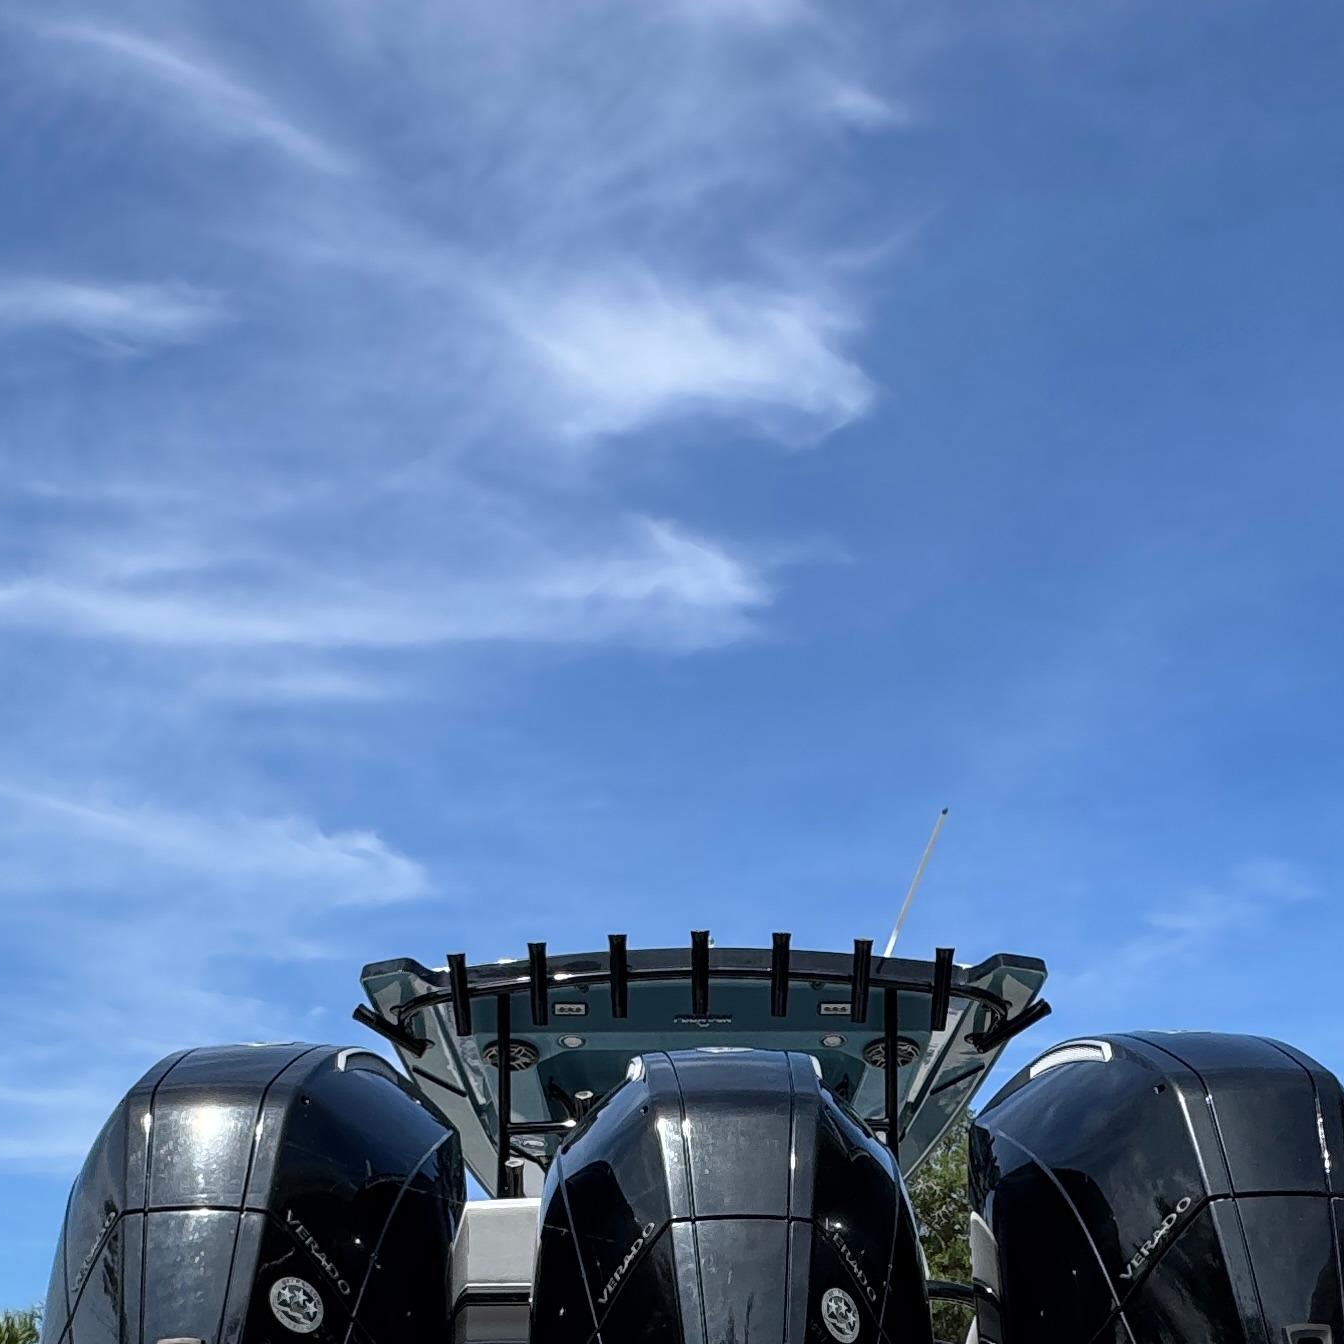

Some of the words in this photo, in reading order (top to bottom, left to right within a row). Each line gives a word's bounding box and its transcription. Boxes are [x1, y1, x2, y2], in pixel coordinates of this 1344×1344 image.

[286, 1209, 350, 1294] VERADO
[598, 1222, 655, 1304] VERADO
[1120, 1197, 1191, 1278] VERADO
